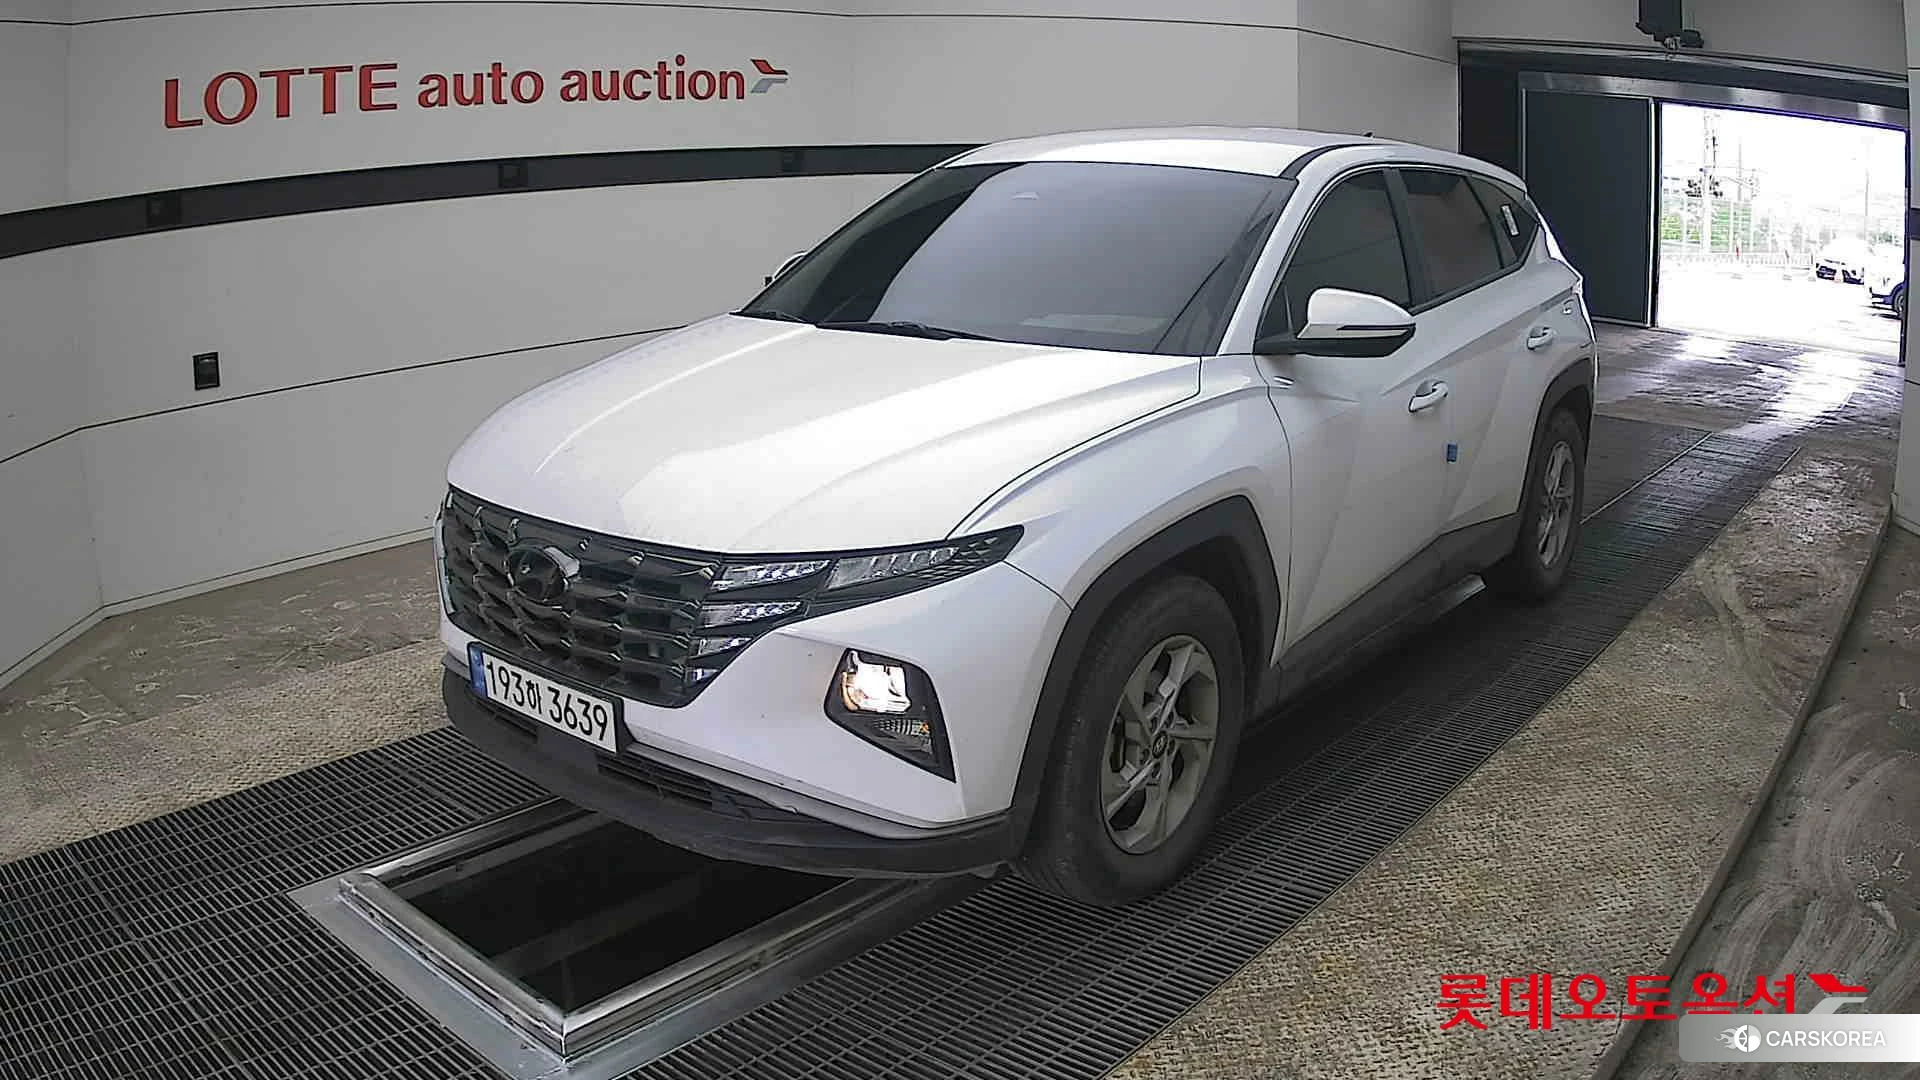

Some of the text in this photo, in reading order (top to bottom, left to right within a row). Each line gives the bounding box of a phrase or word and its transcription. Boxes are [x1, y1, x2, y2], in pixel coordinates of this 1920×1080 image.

[163, 55, 746, 129] LOTTE auto auction
[486, 661, 608, 741] 193하 3639
